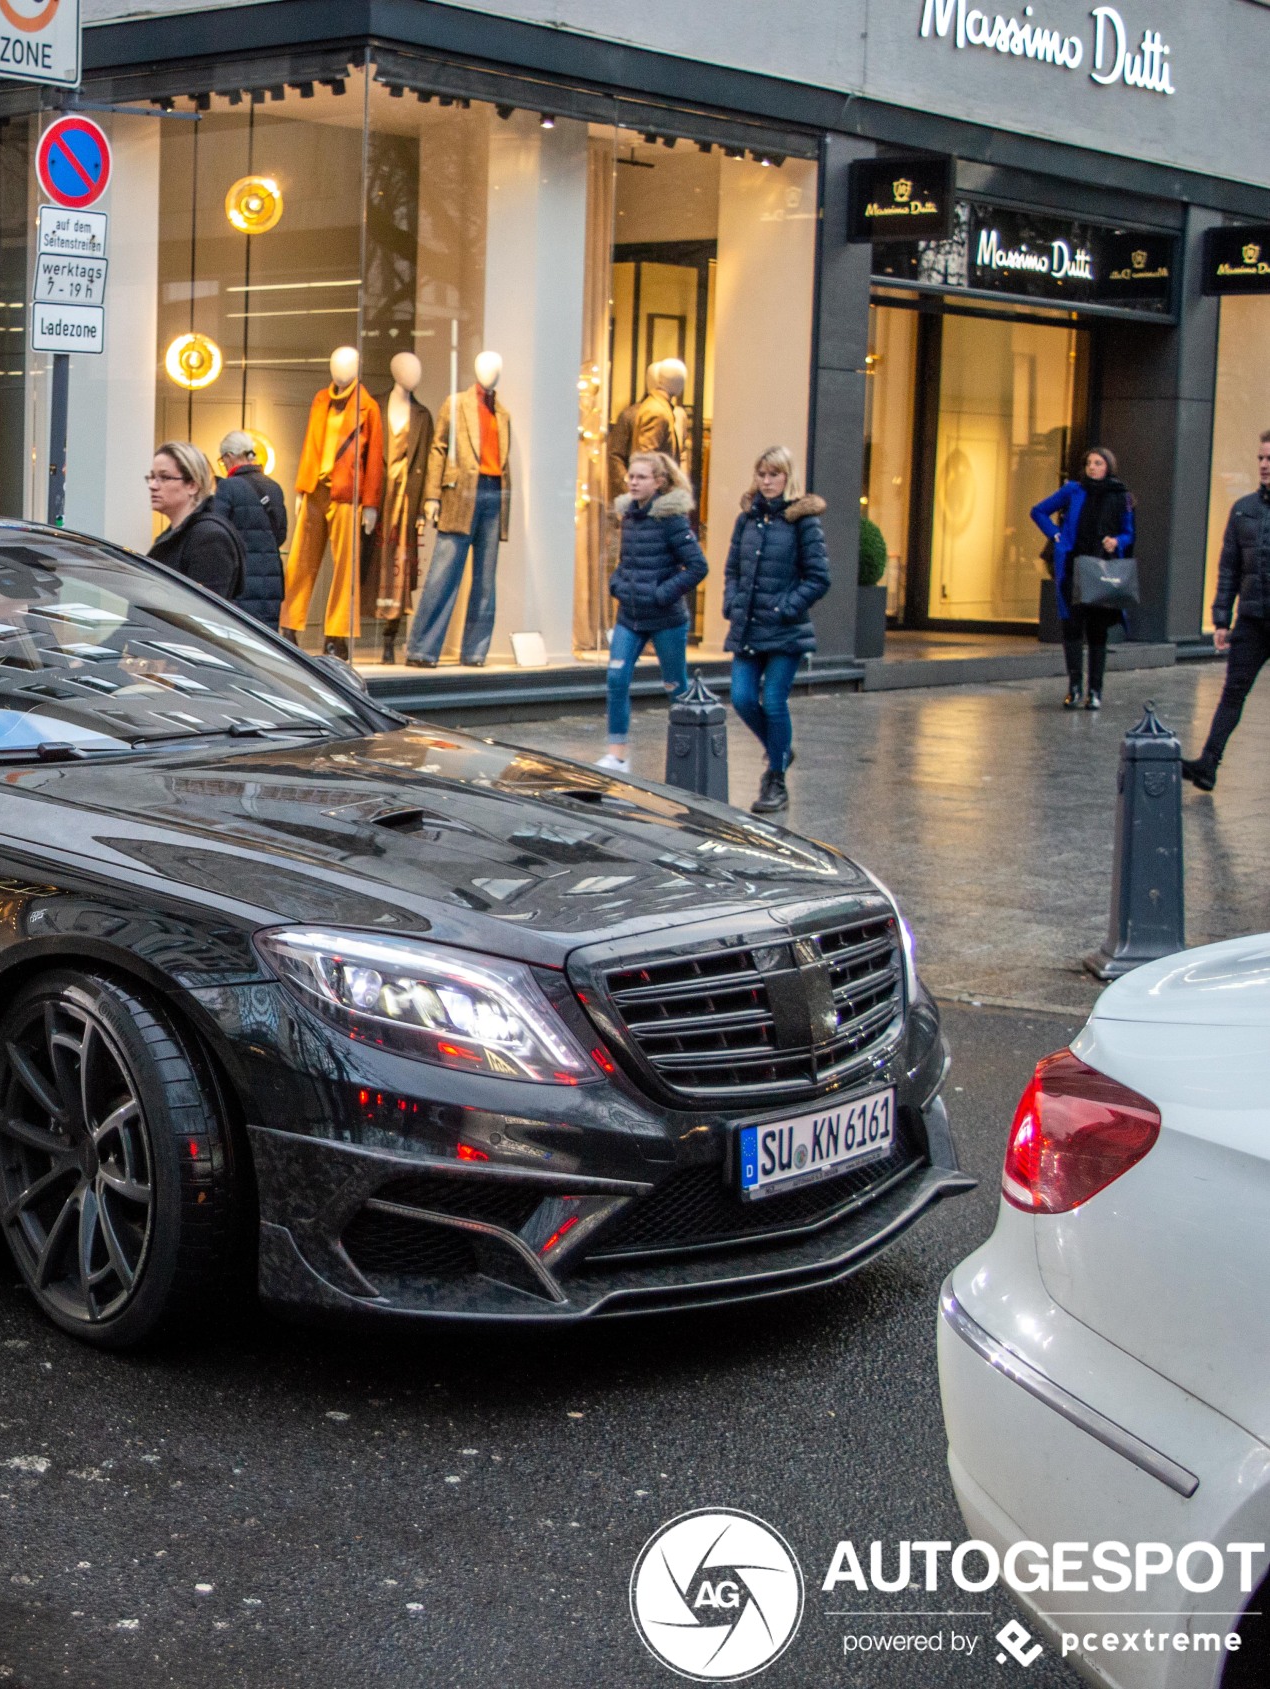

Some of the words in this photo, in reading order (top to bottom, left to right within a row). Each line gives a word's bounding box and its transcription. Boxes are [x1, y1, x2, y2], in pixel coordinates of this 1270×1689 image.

[0, 36, 53, 70] ZONE
[921, 0, 1083, 69] Massimo
[1090, 6, 1176, 95] Dutti
[865, 202, 910, 217] Massimo
[910, 200, 938, 215] Dutti
[55, 219, 71, 232] auf
[73, 220, 92, 234] dem
[43, 233, 102, 253] Seitenstreifen
[976, 228, 1049, 273] Massimo
[1050, 240, 1094, 280] Dutti
[42, 261, 103, 283] werktags
[47, 280, 55, 295] 7
[69, 283, 83, 298] 19
[85, 284, 93, 298] h
[40, 317, 97, 339] Ladezone
[746, 1165, 754, 1178] D
[761, 1126, 794, 1177] SU
[811, 1114, 840, 1163] KN
[844, 1096, 890, 1151] 6161
